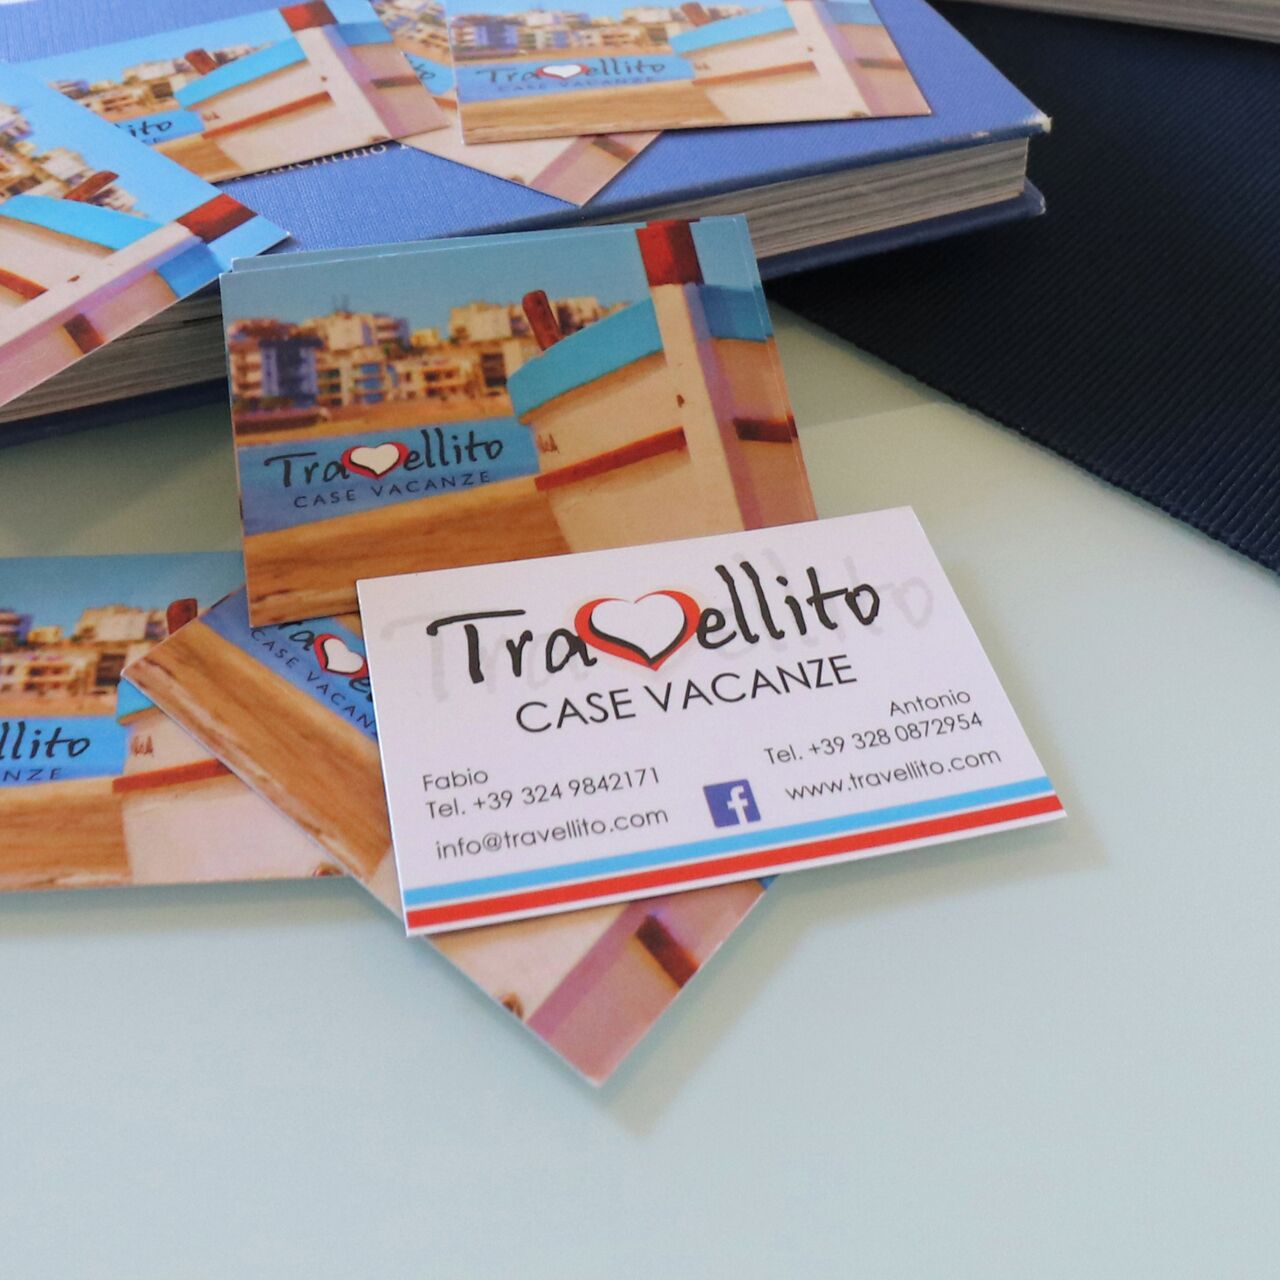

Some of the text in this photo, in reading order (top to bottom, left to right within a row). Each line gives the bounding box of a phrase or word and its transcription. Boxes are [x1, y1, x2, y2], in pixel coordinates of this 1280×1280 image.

[293, 470, 491, 509] CASE VACANZE
[250, 629, 300, 670] CASE
[515, 654, 858, 733] CASE VACANZE
[889, 689, 972, 717] Antonio
[764, 711, 983, 766] Tel. +39 328 0872954
[422, 767, 489, 792] Fabio
[426, 766, 660, 820] Tel. +39 324 9842171
[784, 747, 1002, 801] www.travellito.com
[436, 808, 669, 860] info@travellito.com
